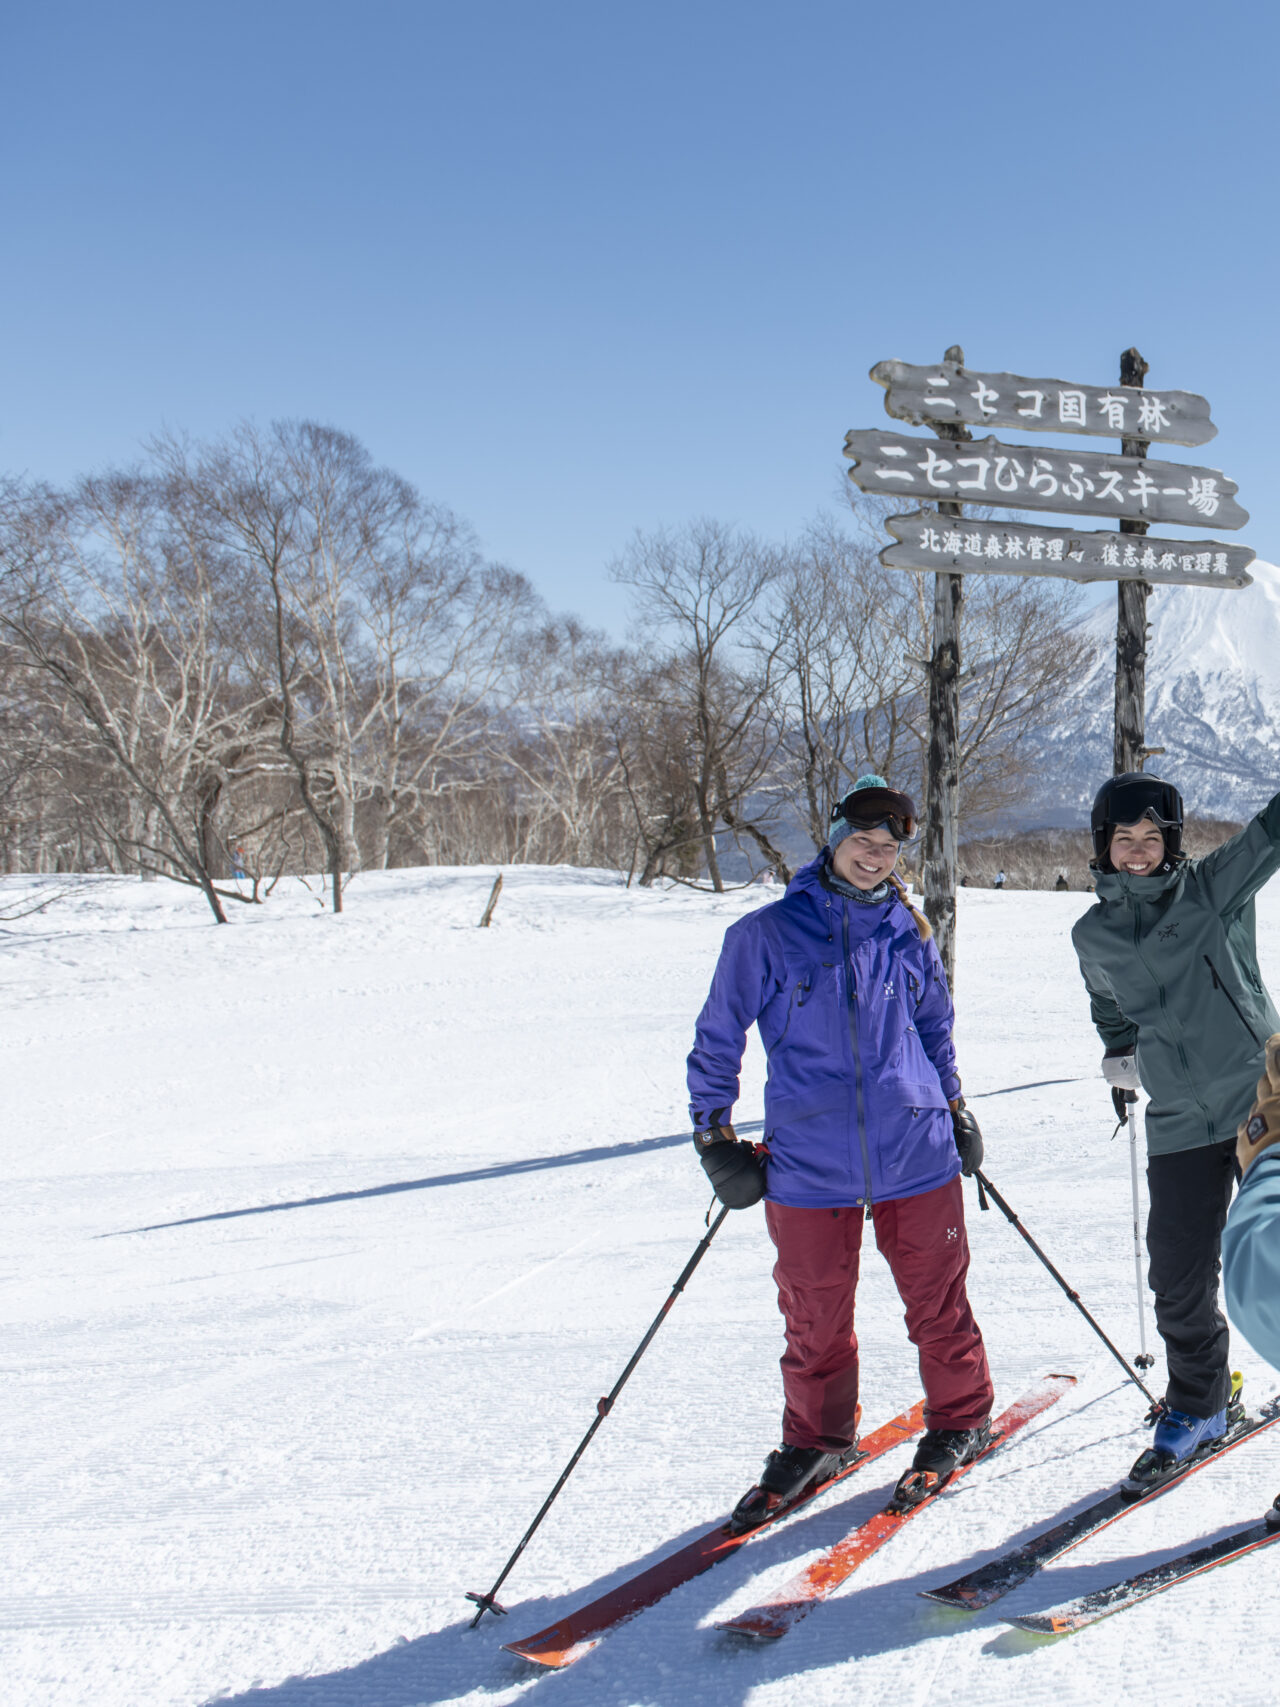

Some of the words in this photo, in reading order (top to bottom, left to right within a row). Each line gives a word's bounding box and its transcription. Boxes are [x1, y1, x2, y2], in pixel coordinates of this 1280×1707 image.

[923, 377, 1171, 434] ニセコ国有林
[874, 446, 1220, 517] ニセコひらふスキー場
